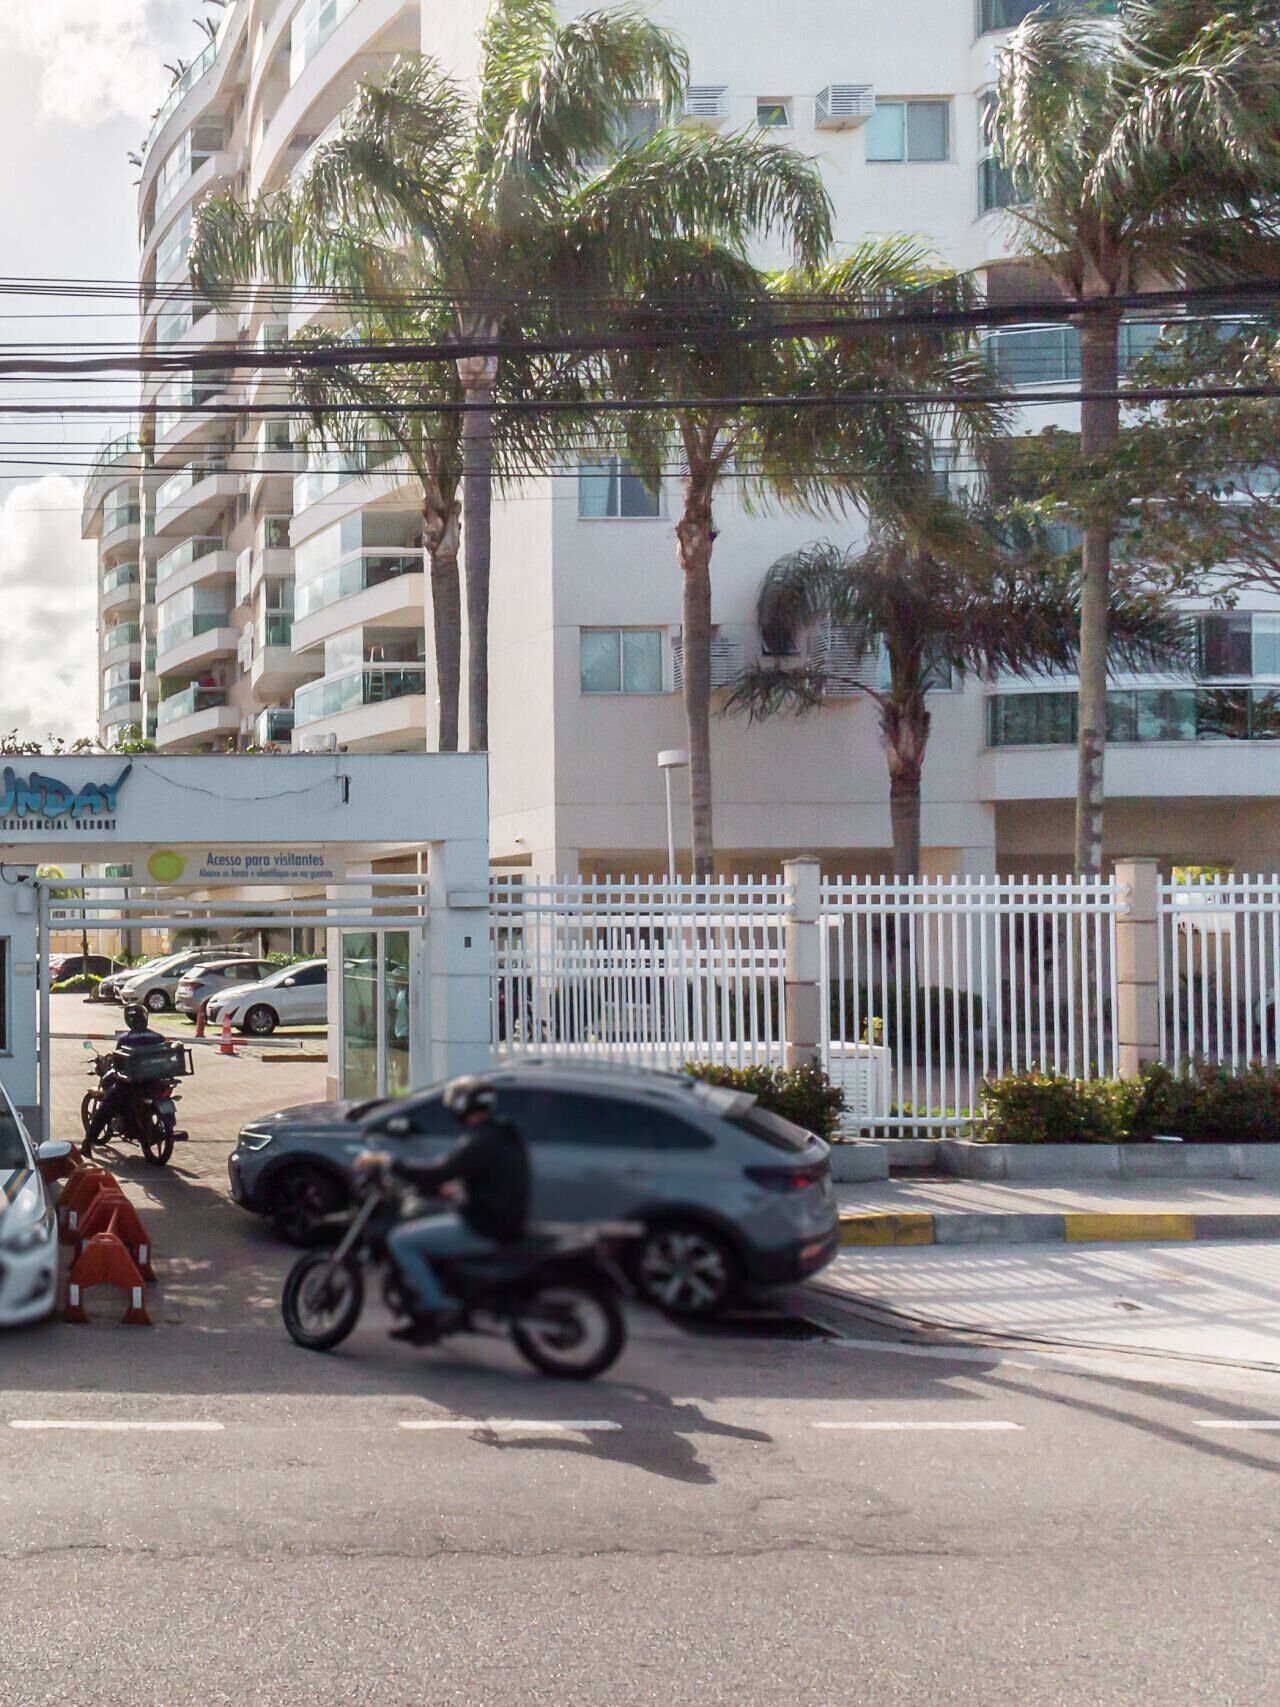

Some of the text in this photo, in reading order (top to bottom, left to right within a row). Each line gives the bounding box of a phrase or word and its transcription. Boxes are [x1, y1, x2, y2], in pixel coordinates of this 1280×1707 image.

[76, 819, 117, 830] RESORT
[206, 852, 324, 869] Acesso para visitantes
